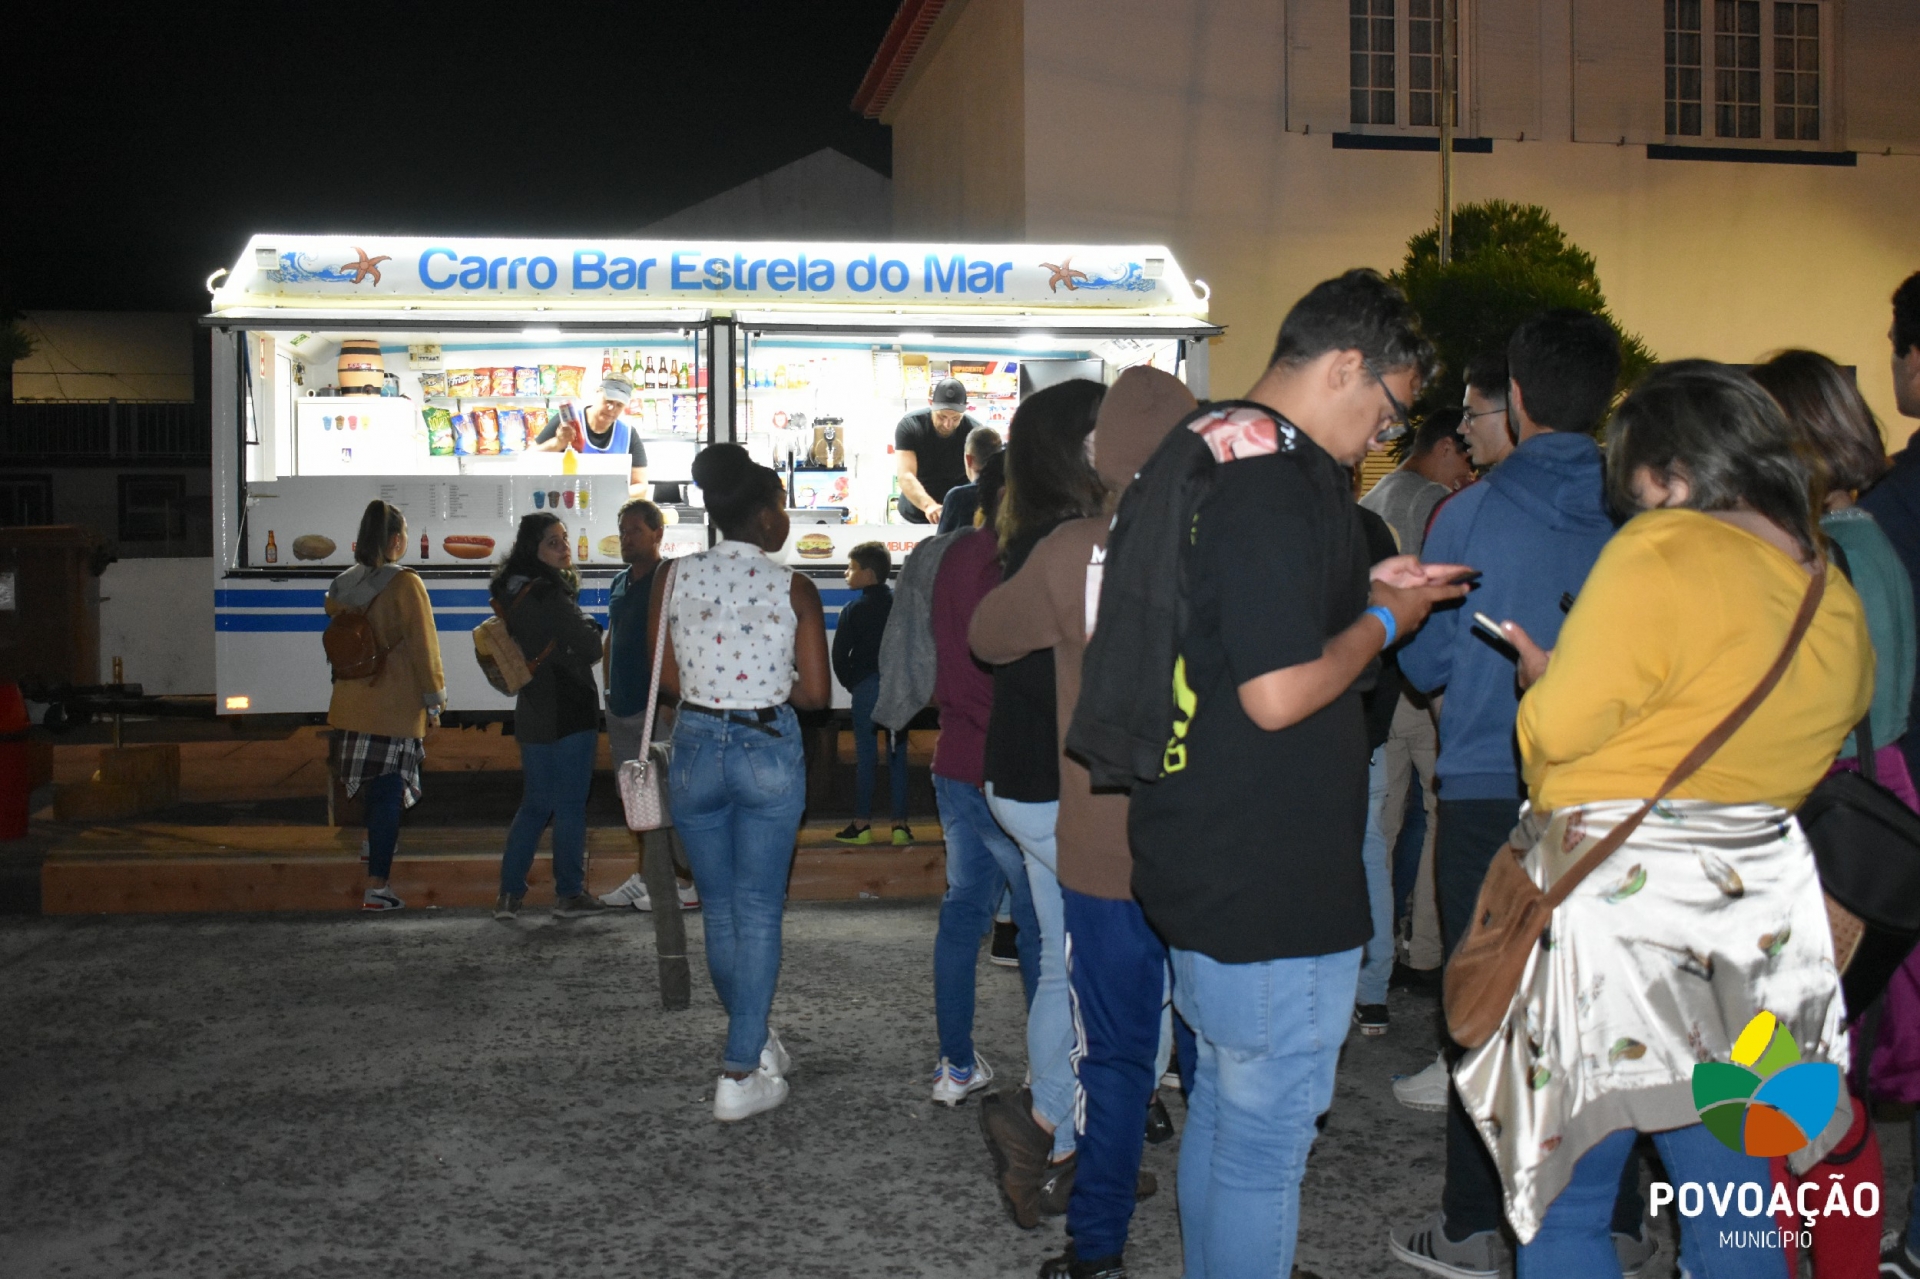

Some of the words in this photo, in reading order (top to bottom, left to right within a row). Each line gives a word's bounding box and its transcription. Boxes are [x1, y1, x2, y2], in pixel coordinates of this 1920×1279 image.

[418, 247, 558, 290] Carro
[572, 249, 657, 290] Bar
[670, 249, 835, 292] Estrela
[846, 251, 910, 293] do
[923, 252, 1013, 294] Mar
